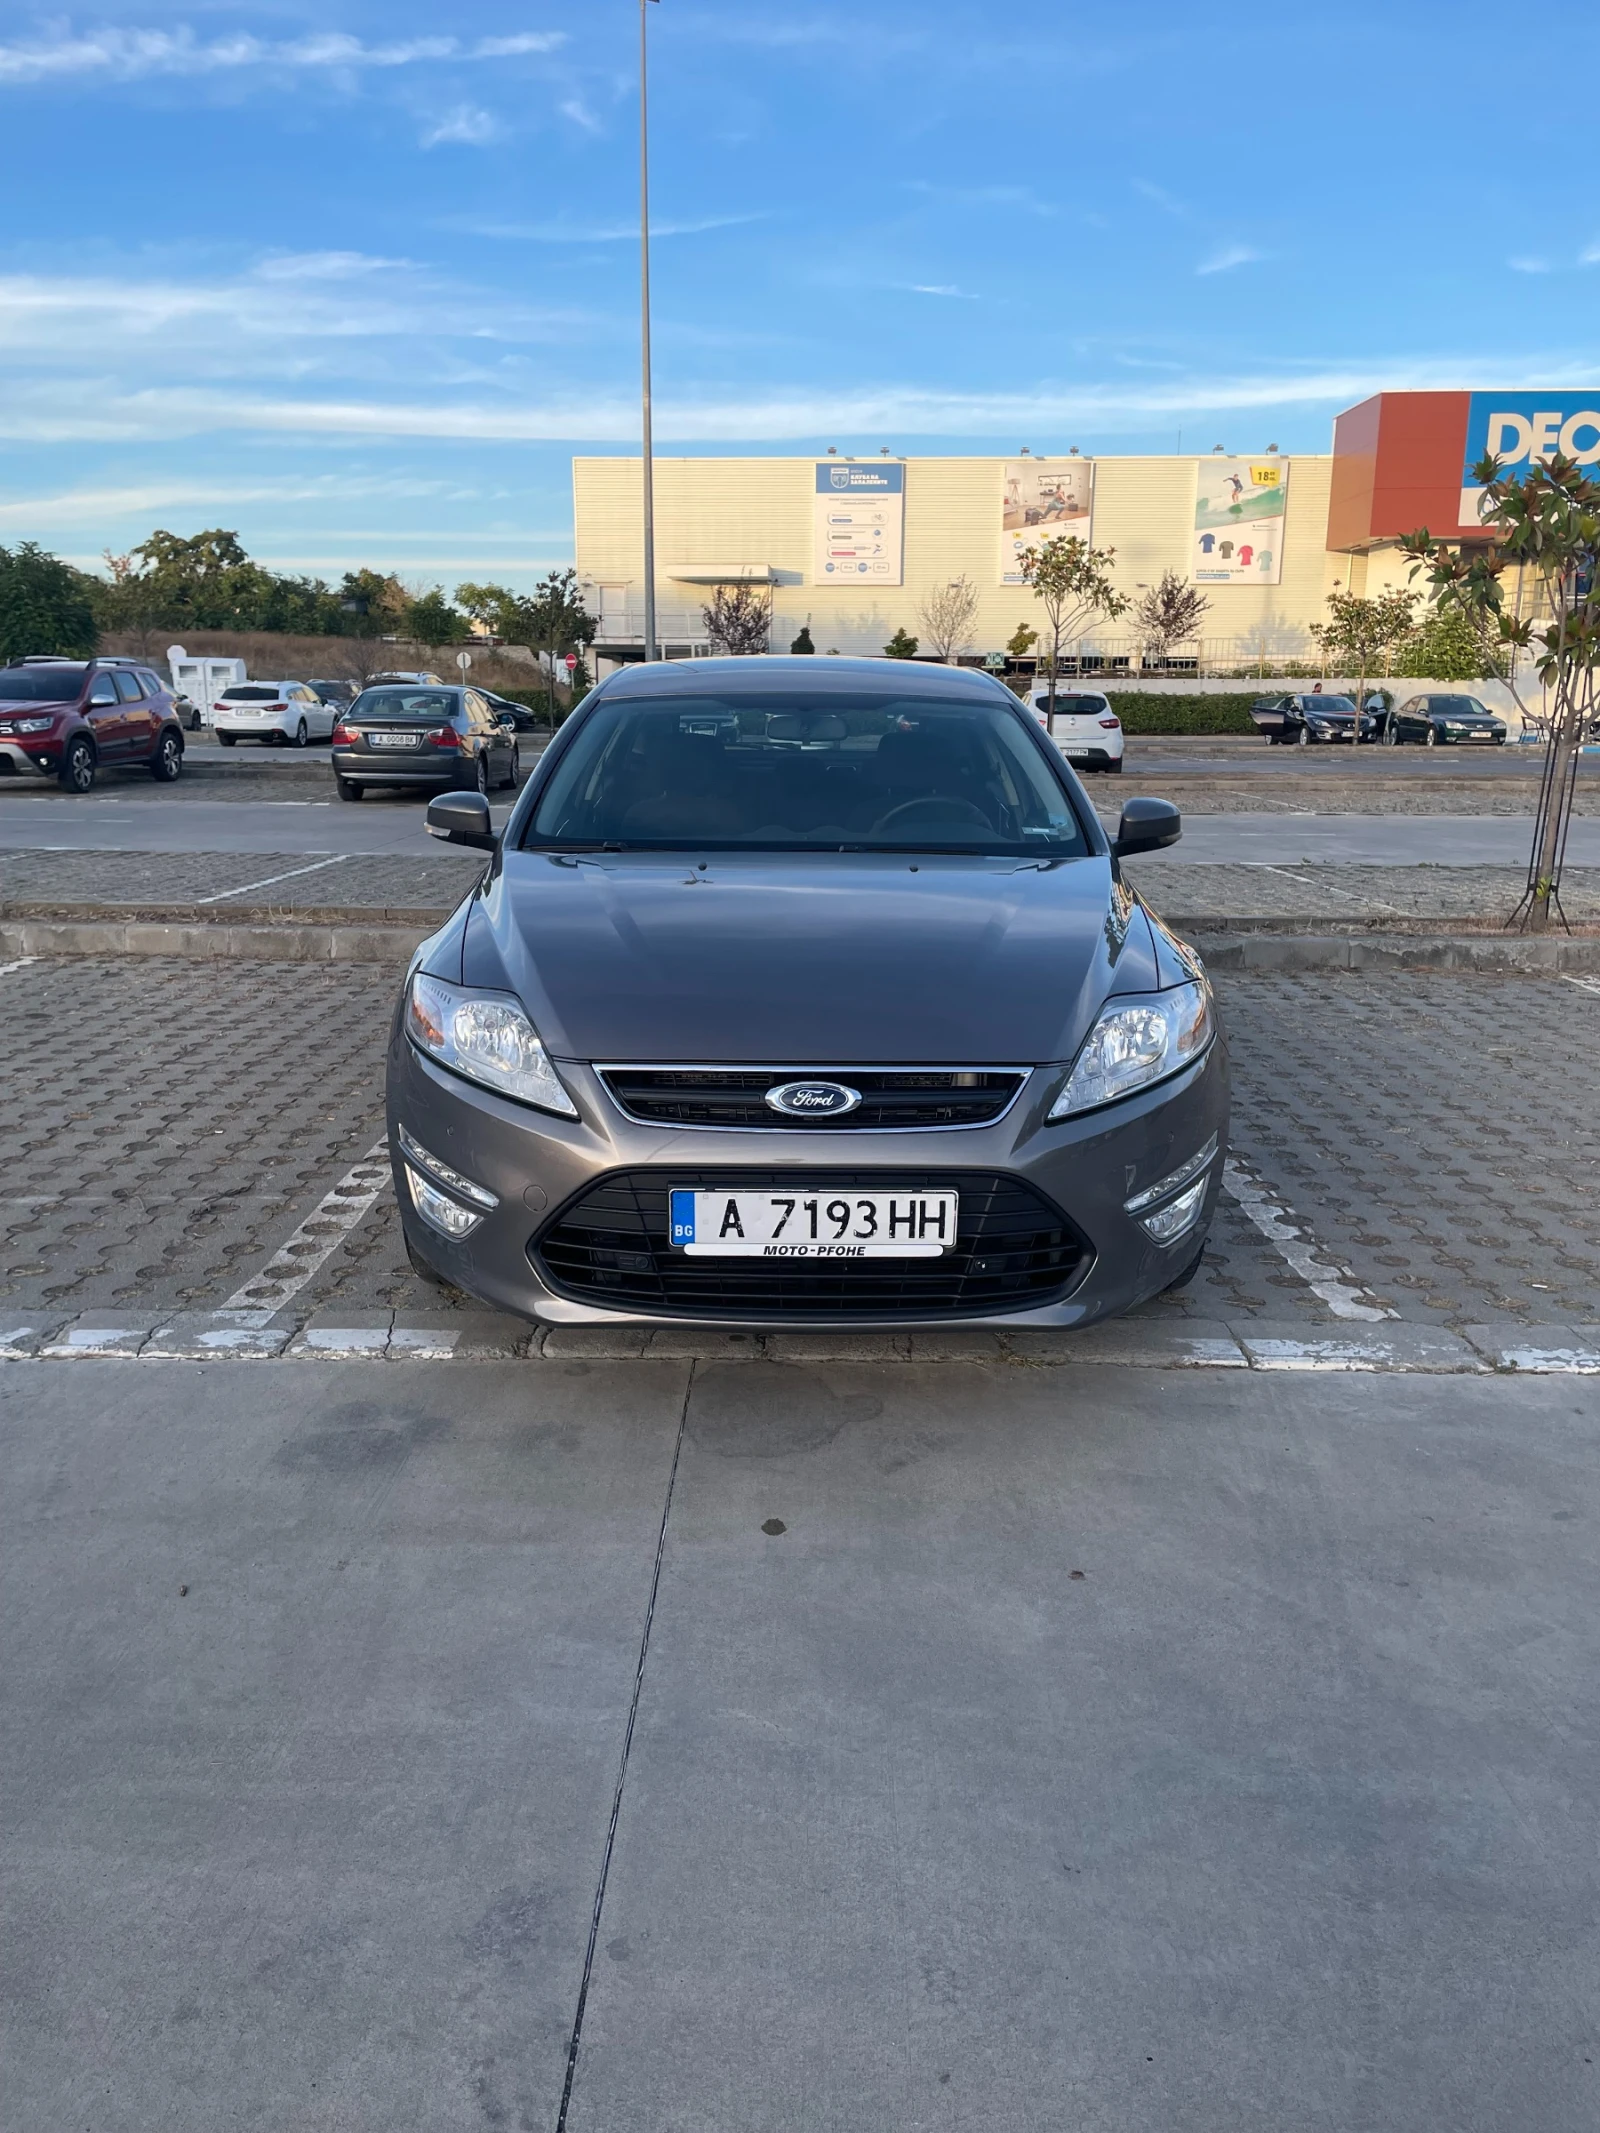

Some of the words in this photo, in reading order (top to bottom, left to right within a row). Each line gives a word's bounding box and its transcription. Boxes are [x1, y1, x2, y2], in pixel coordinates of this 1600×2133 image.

[1487, 411, 1600, 465] DEC
[792, 1089, 835, 1107] Ford
[674, 1224, 693, 1237] BG
[719, 1199, 745, 1238] A
[771, 1199, 878, 1239] 7193
[889, 1200, 946, 1239] HH
[763, 1245, 866, 1257] MOTO-PFOHE
